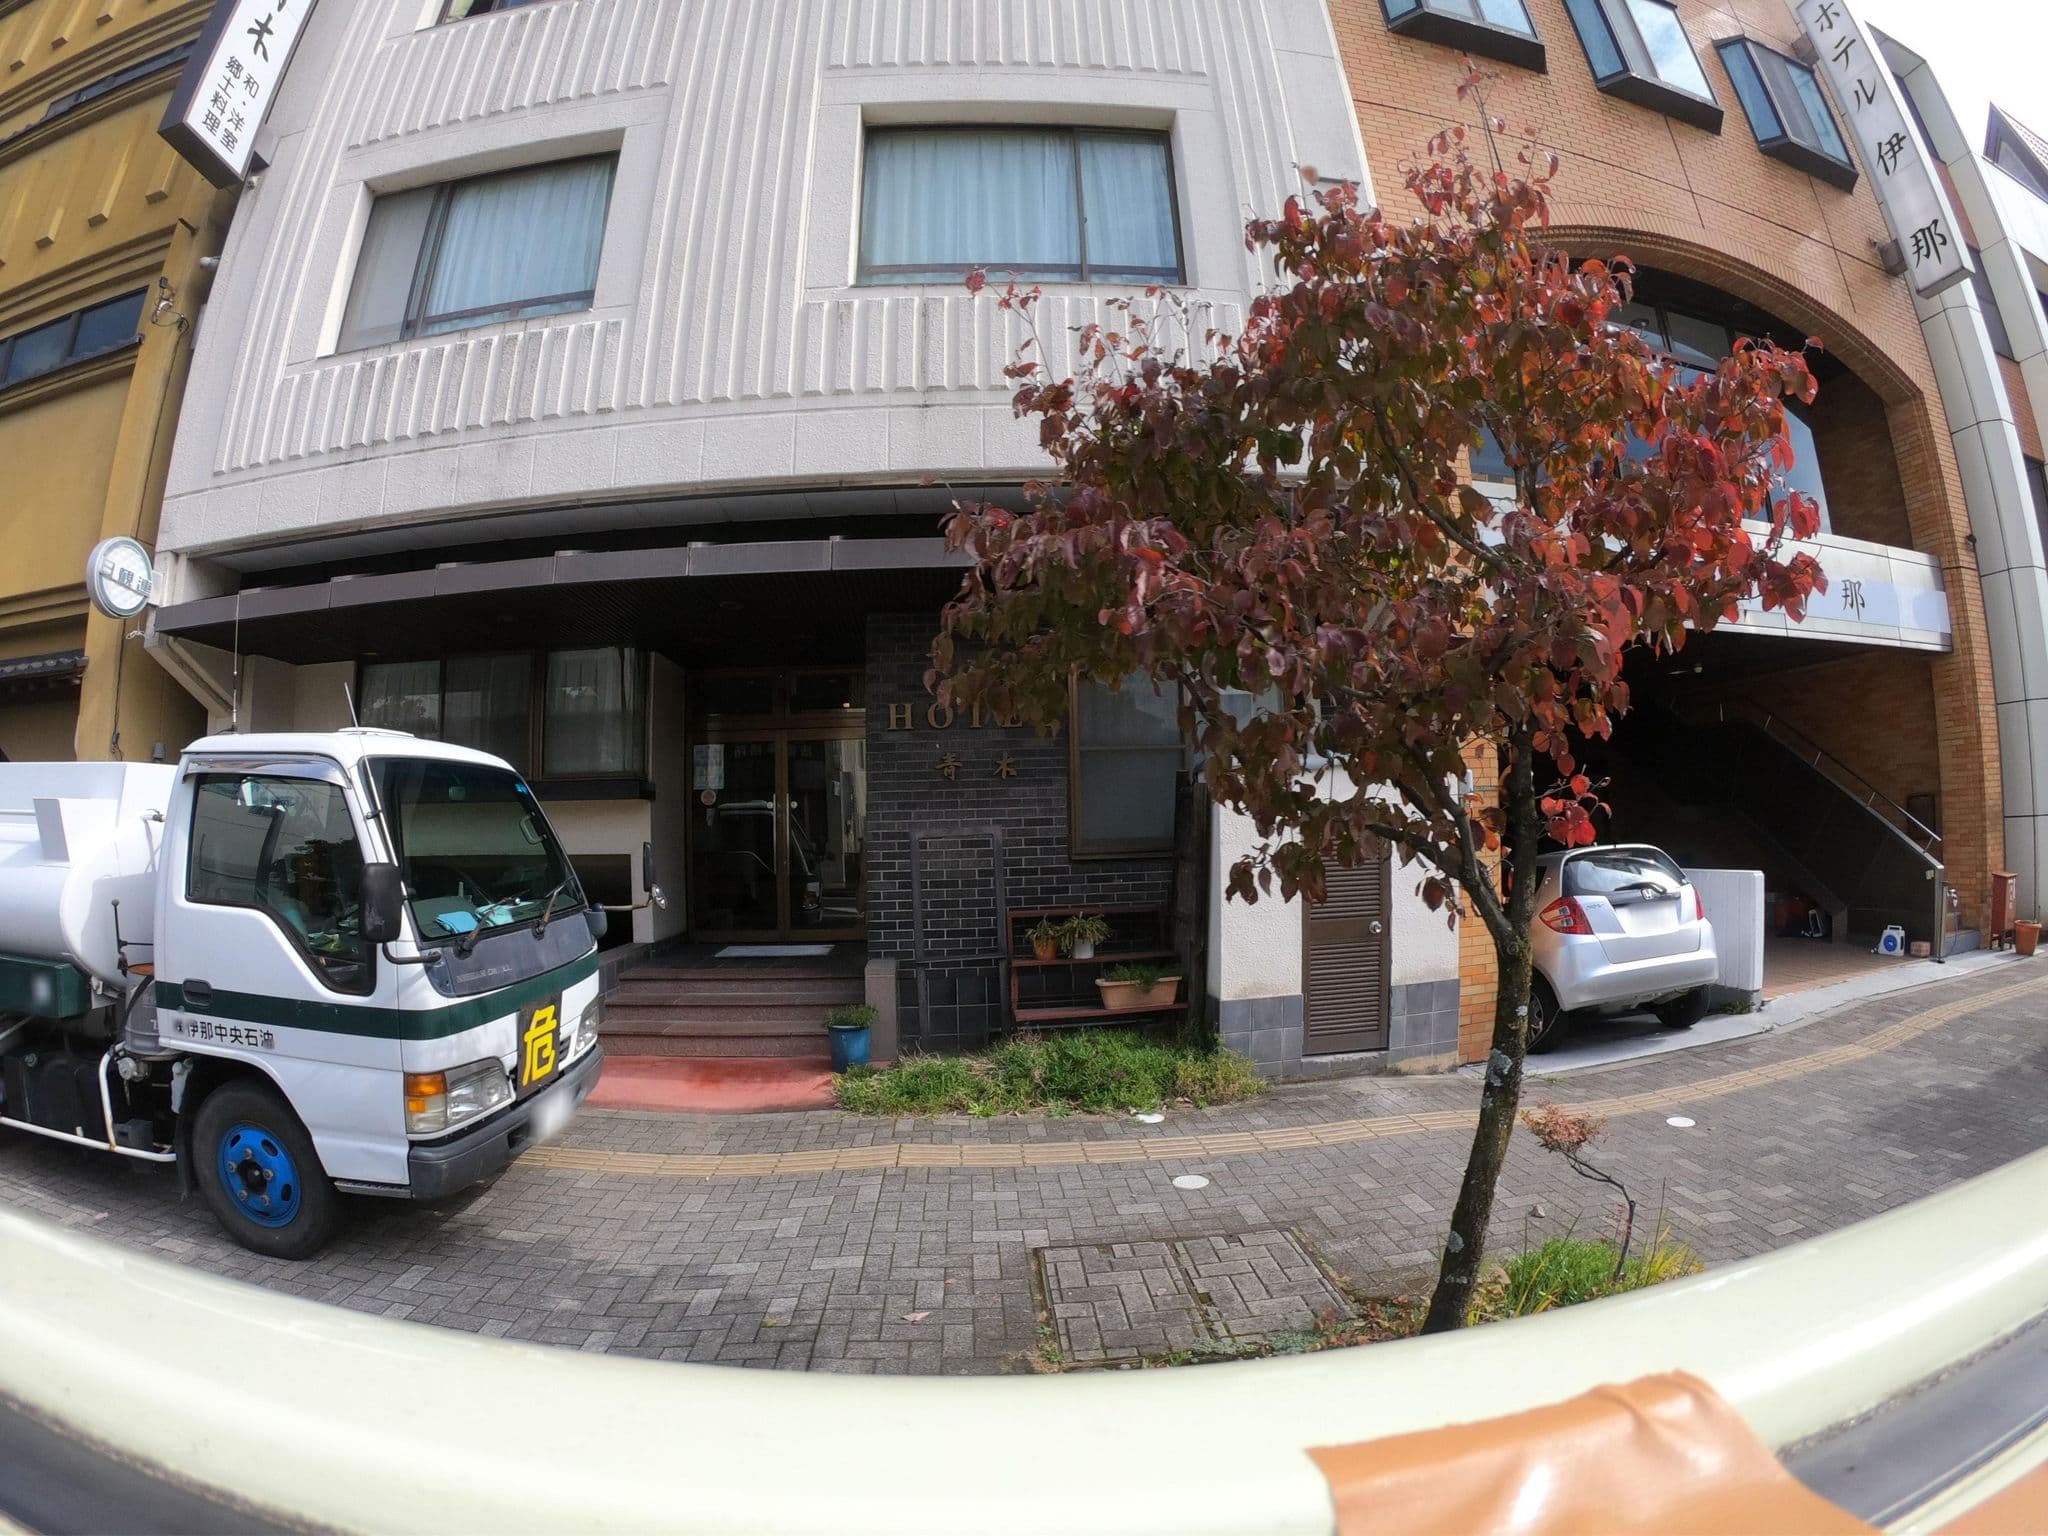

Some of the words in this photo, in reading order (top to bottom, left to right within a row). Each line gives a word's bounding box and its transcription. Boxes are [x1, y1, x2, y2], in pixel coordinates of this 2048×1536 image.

[247, 0, 287, 63] 木
[202, 56, 244, 136] 郷土料理
[1815, 2, 1947, 268] ホテル伊那
[936, 752, 1018, 781] 青木
[522, 1004, 558, 1087] 危
